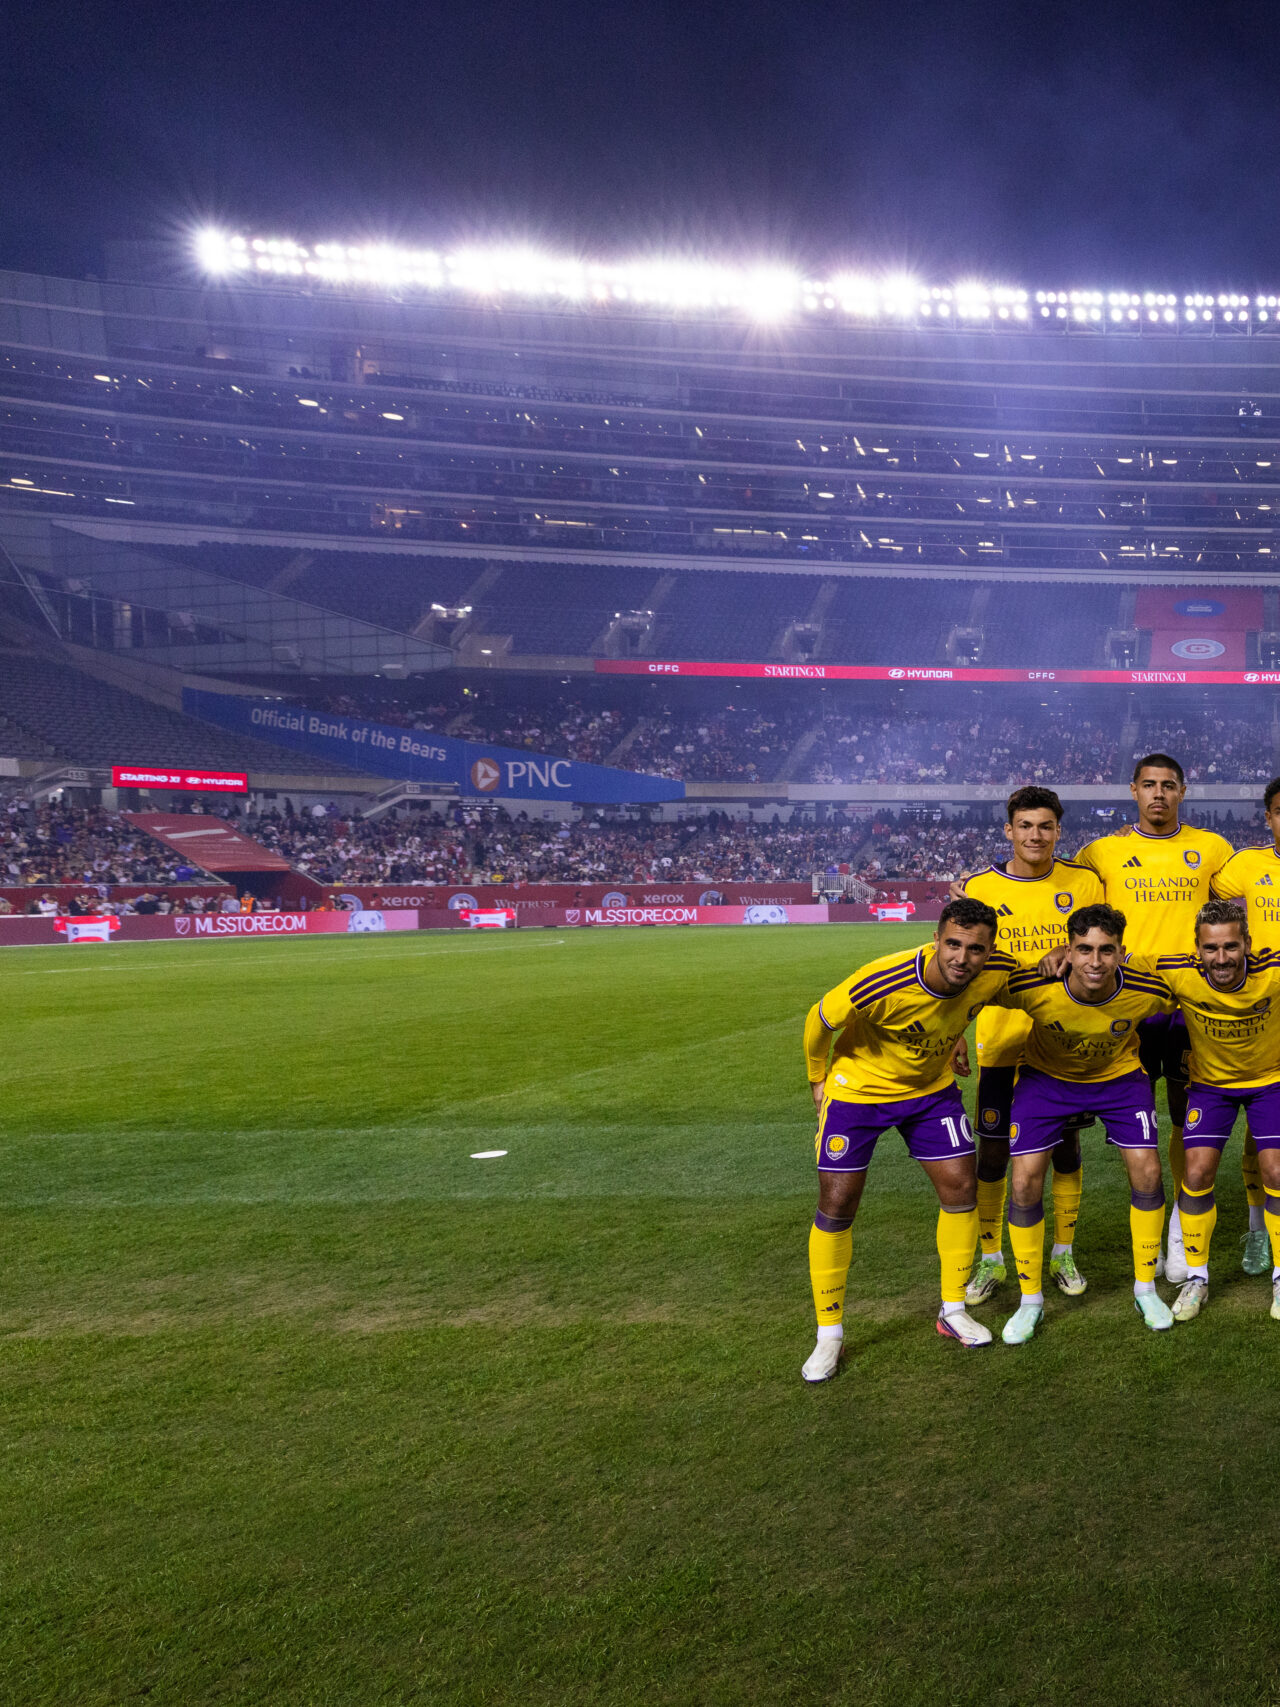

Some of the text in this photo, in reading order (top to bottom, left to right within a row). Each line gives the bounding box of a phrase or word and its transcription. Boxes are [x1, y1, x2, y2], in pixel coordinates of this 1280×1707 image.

[764, 666, 825, 677] STARTING XI
[907, 669, 953, 679] HYUNDAI
[1131, 672, 1186, 682] STARTING XI
[251, 708, 447, 762] Official Bank of the Bears
[119, 773, 168, 783] STARTING
[505, 761, 572, 788] PNC
[202, 777, 243, 787] HYUNDAI
[1125, 876, 1200, 889] ORLANDO
[643, 894, 685, 904] xerox
[739, 896, 796, 905] WINTRUST
[1135, 890, 1193, 902] HEALTH
[1195, 1010, 1272, 1028] ORLANDO
[1204, 1023, 1266, 1039] HEALTH
[941, 1113, 975, 1148] 10
[821, 1285, 845, 1295] LIONS
